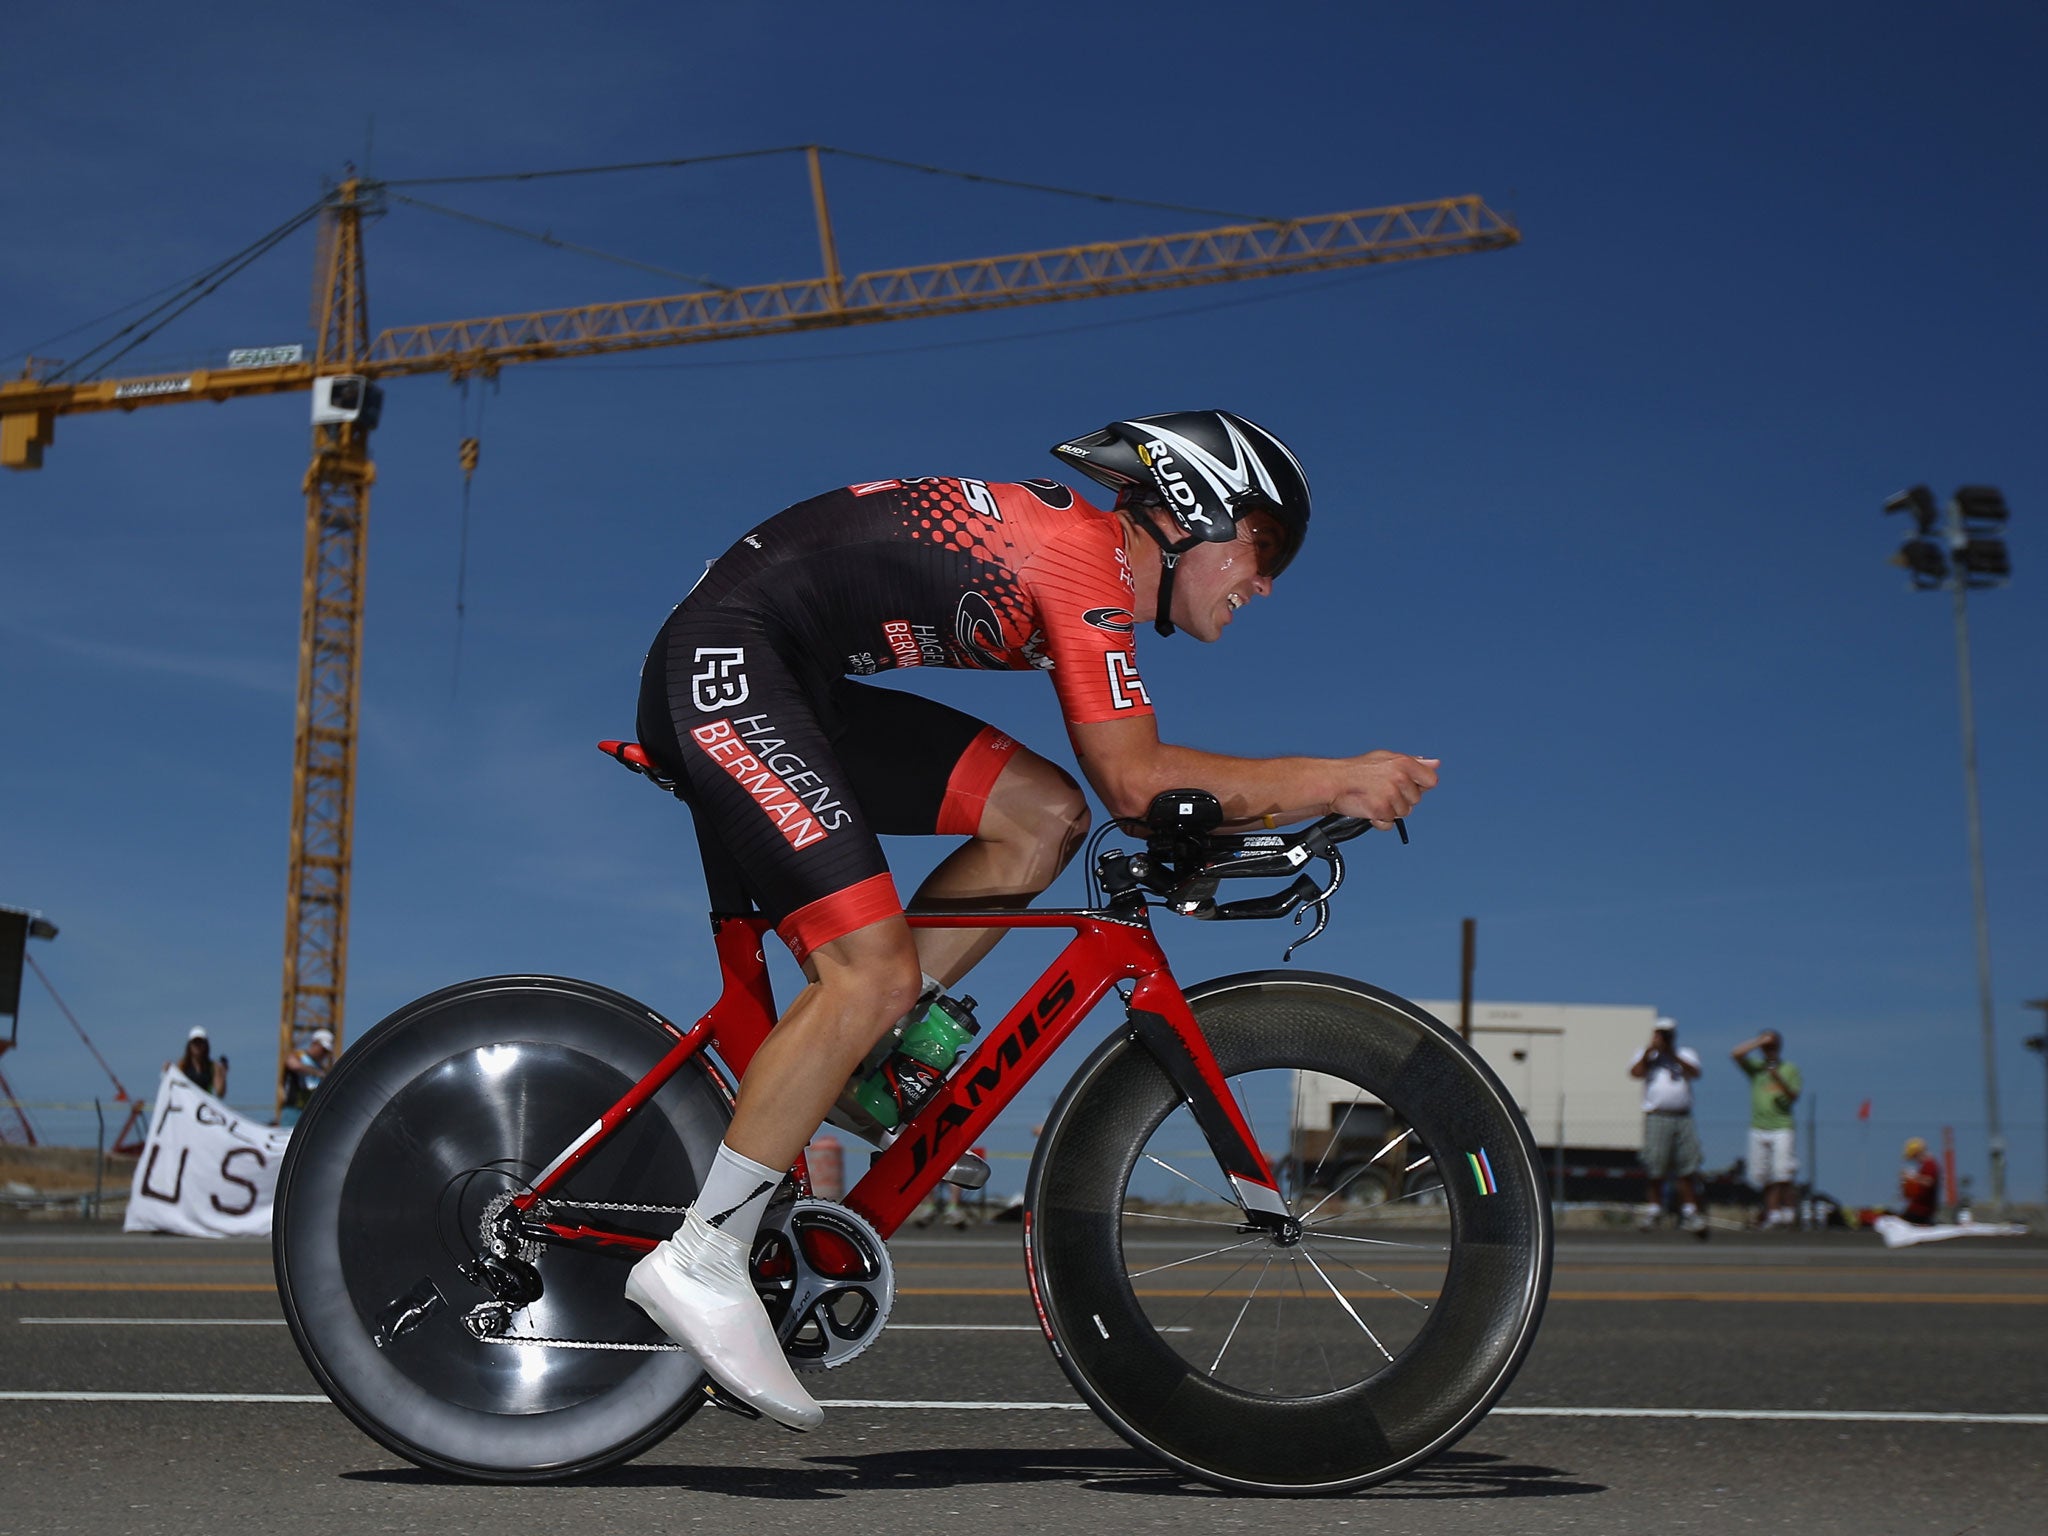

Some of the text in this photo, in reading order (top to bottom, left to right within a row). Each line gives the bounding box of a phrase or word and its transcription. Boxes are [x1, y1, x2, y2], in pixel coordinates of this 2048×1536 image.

[1059, 444, 1091, 456] RUDY
[1145, 439, 1213, 526] RUDY
[1149, 467, 1193, 531] PROJECT
[692, 719, 825, 849] BERMAN
[733, 713, 853, 831] HAGENS
[899, 970, 1076, 1195] JAMIS
